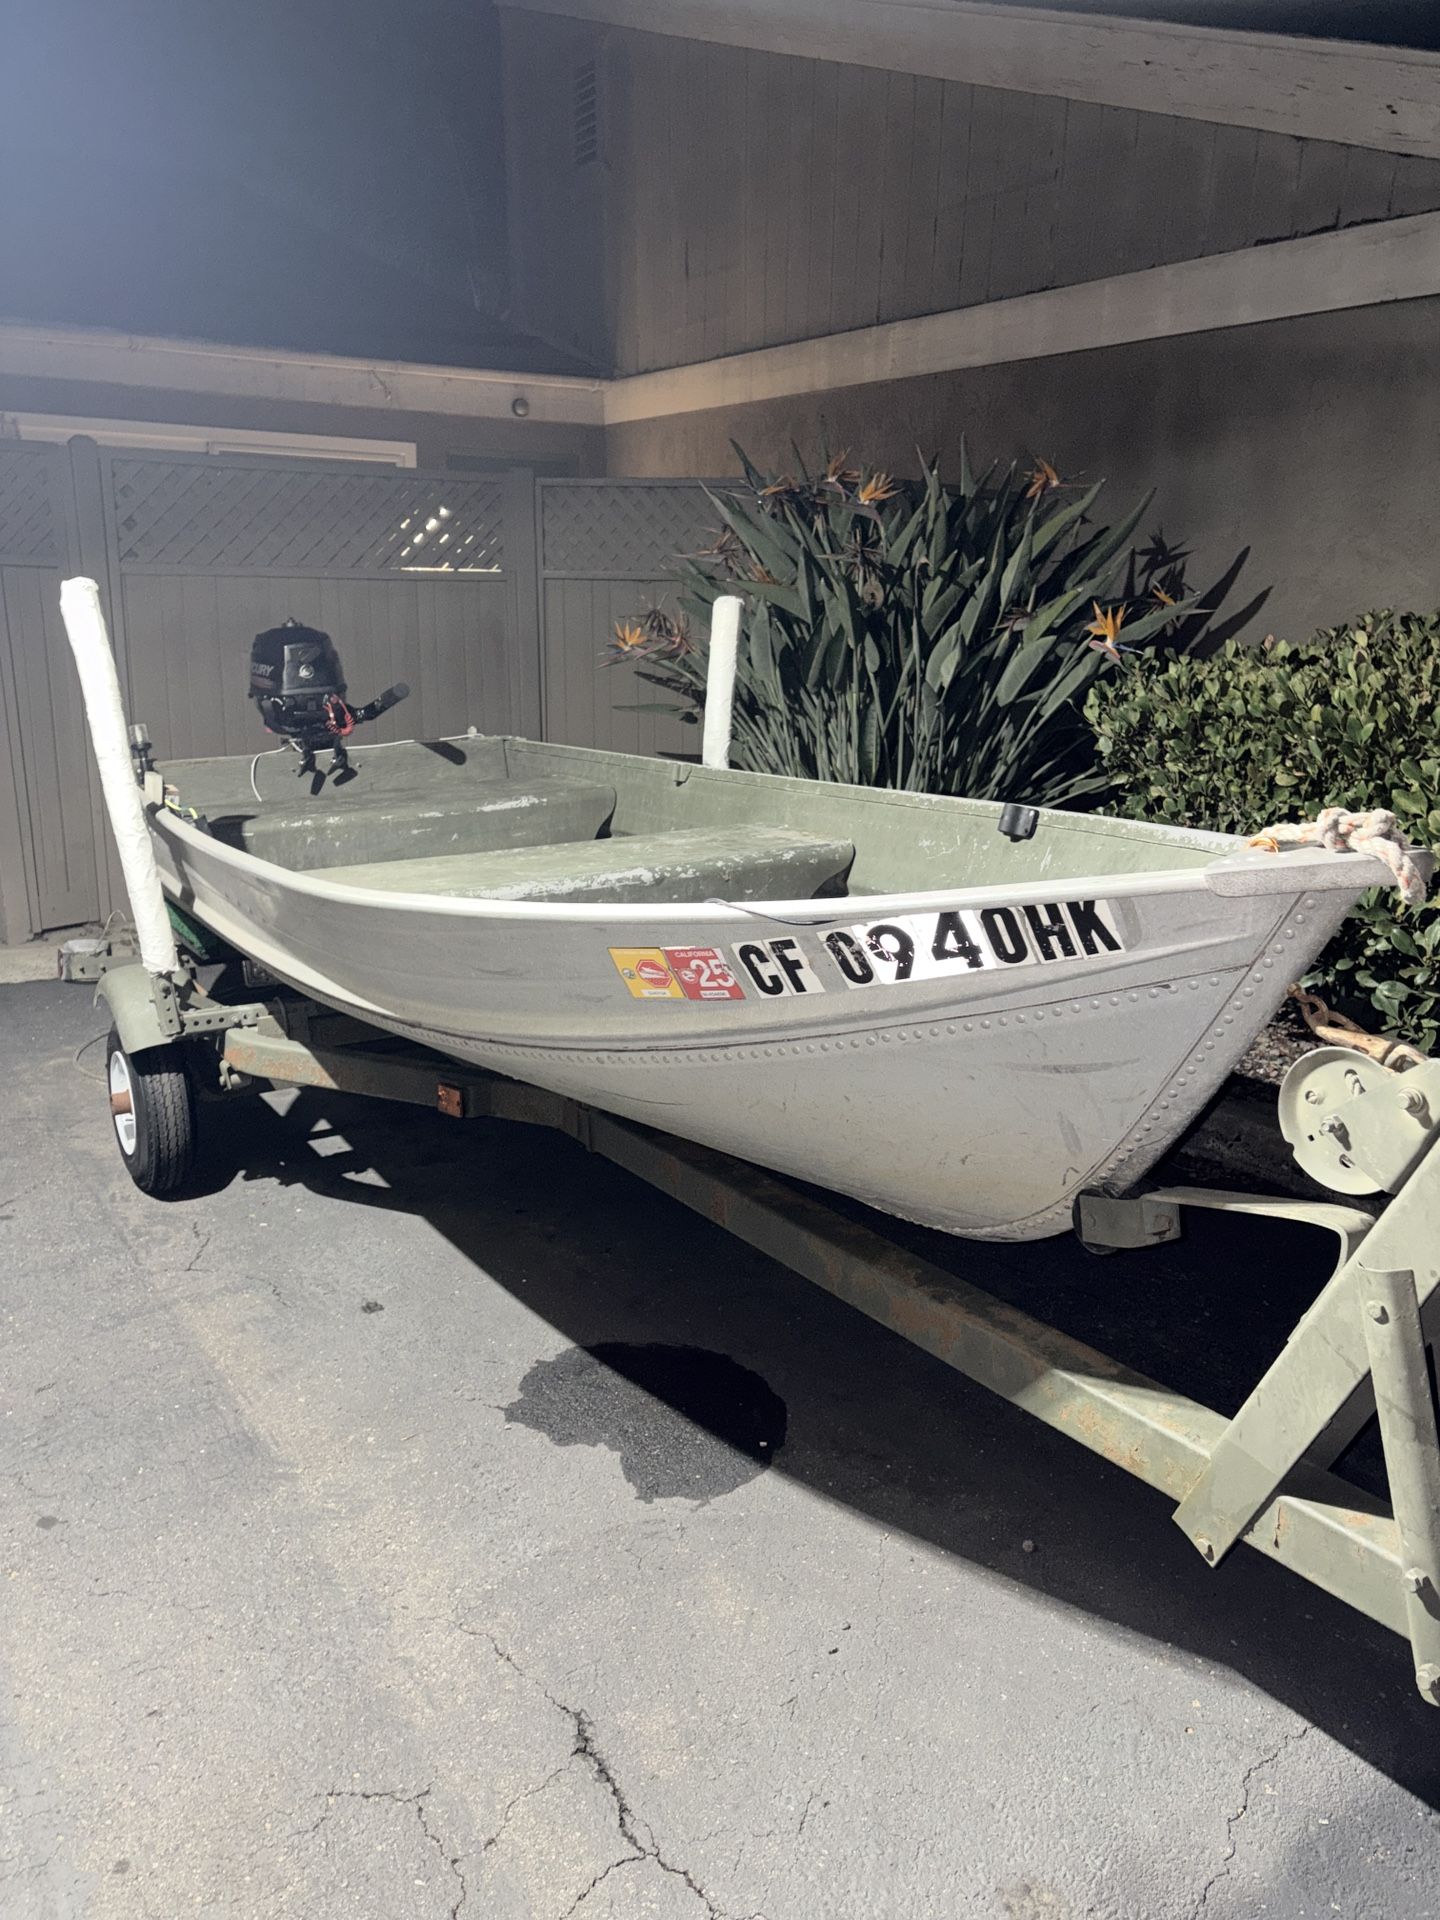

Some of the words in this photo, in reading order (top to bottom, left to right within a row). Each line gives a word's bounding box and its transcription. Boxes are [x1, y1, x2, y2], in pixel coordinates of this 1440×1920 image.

[252, 662, 274, 677] CURY
[690, 959, 735, 987] 25
[739, 939, 807, 995] CF
